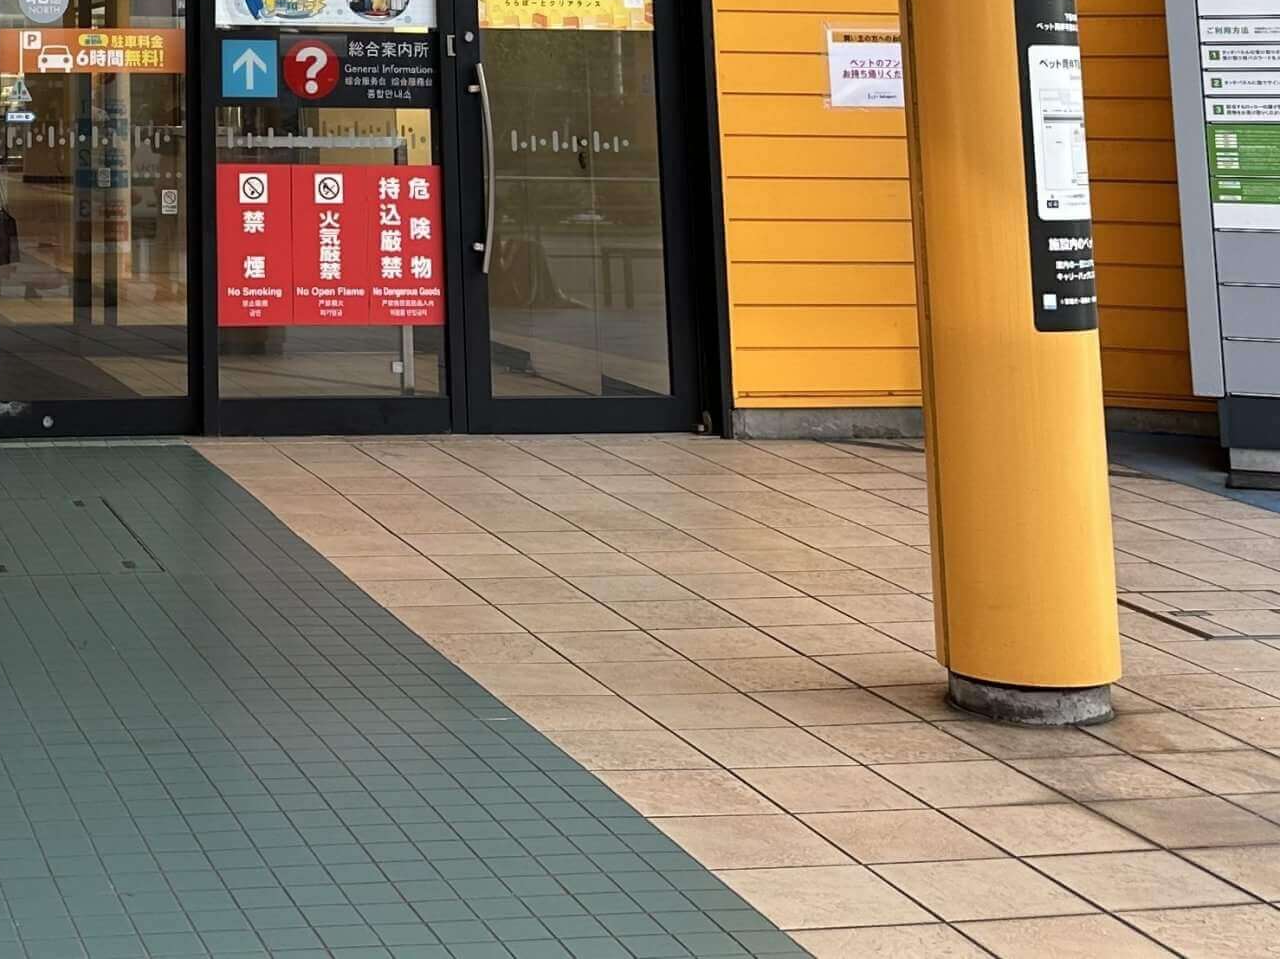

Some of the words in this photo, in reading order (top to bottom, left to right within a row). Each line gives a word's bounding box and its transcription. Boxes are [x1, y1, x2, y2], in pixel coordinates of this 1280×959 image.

[111, 34, 164, 48] 駐車料金
[348, 40, 429, 59] 総合案内所
[344, 63, 380, 74] General
[382, 63, 433, 74] Information
[242, 210, 266, 279] 禁煙
[319, 210, 342, 280] 火気厳禁
[227, 287, 241, 297] No
[242, 287, 283, 298] Smoking
[296, 287, 310, 296] No
[311, 287, 336, 297] Open
[337, 287, 365, 296] Flame
